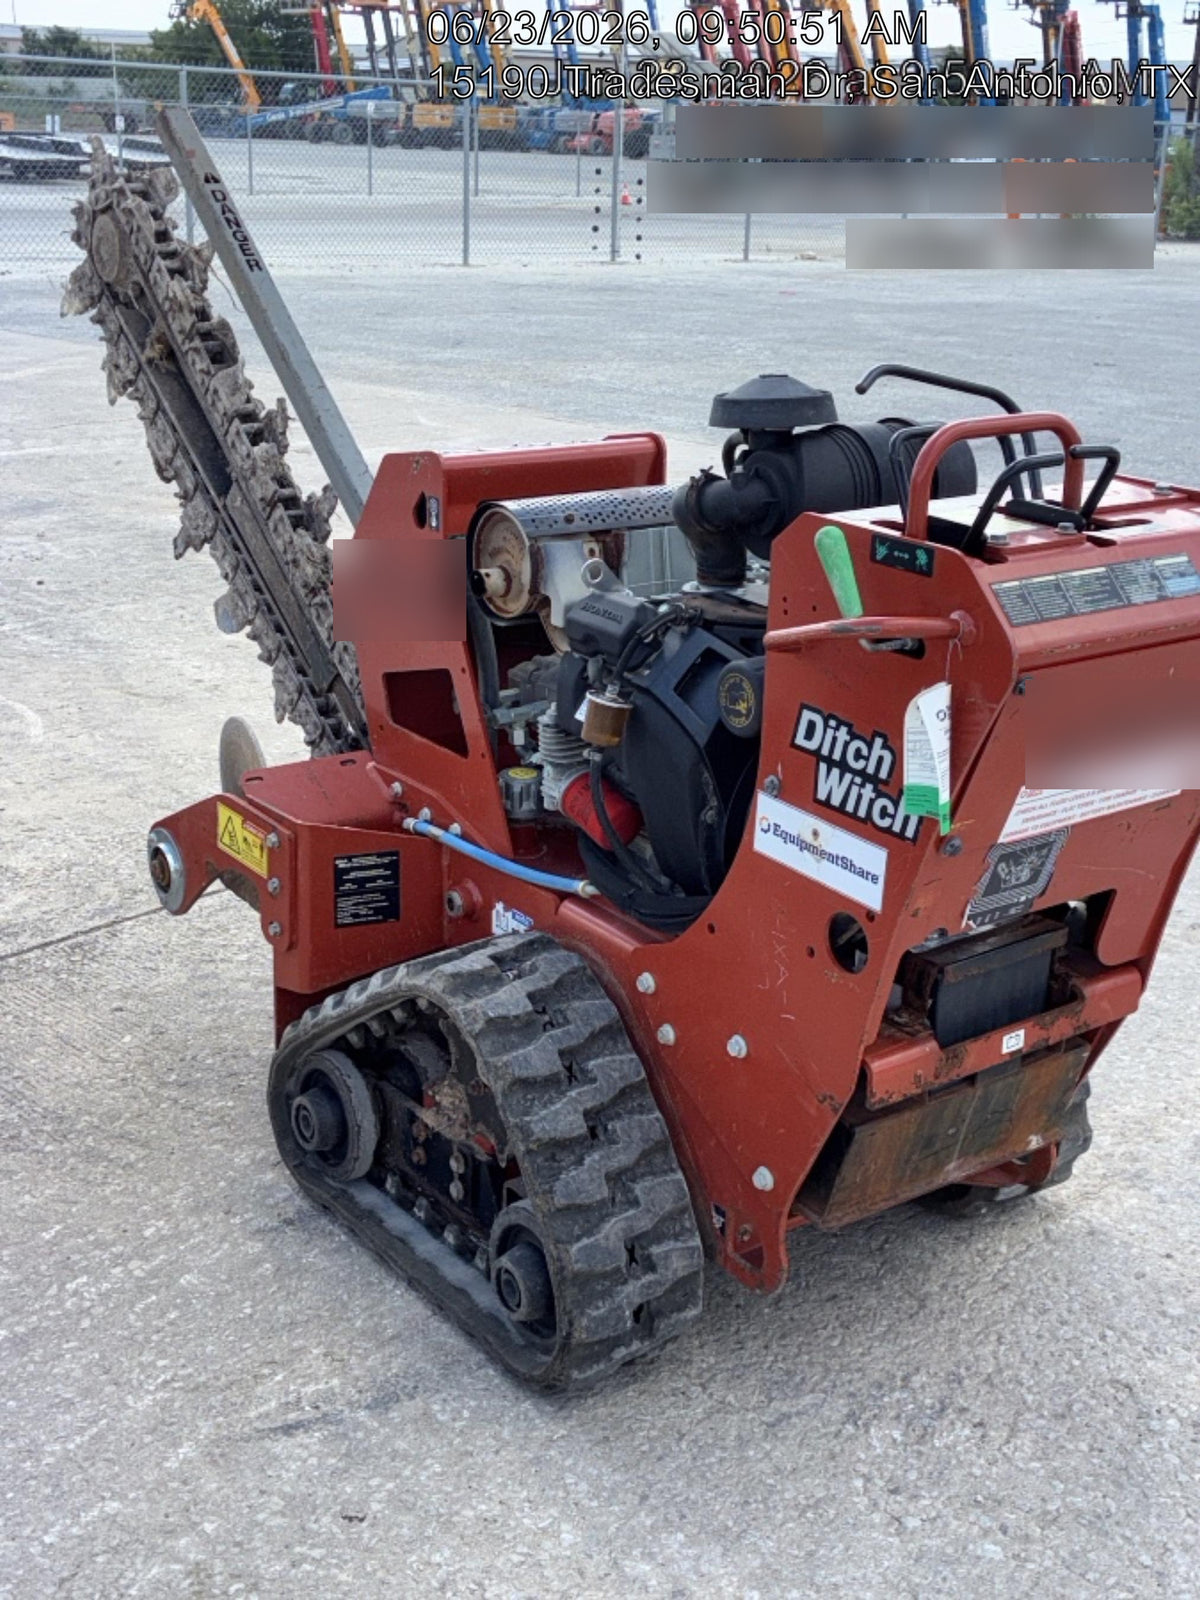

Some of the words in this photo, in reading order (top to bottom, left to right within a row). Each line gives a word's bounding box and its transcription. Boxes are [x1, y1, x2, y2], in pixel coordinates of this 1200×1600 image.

[210, 189, 263, 273] DANGER
[794, 707, 893, 781] Ditch
[815, 761, 921, 839] Witch
[772, 821, 880, 885] EquipmentShare
